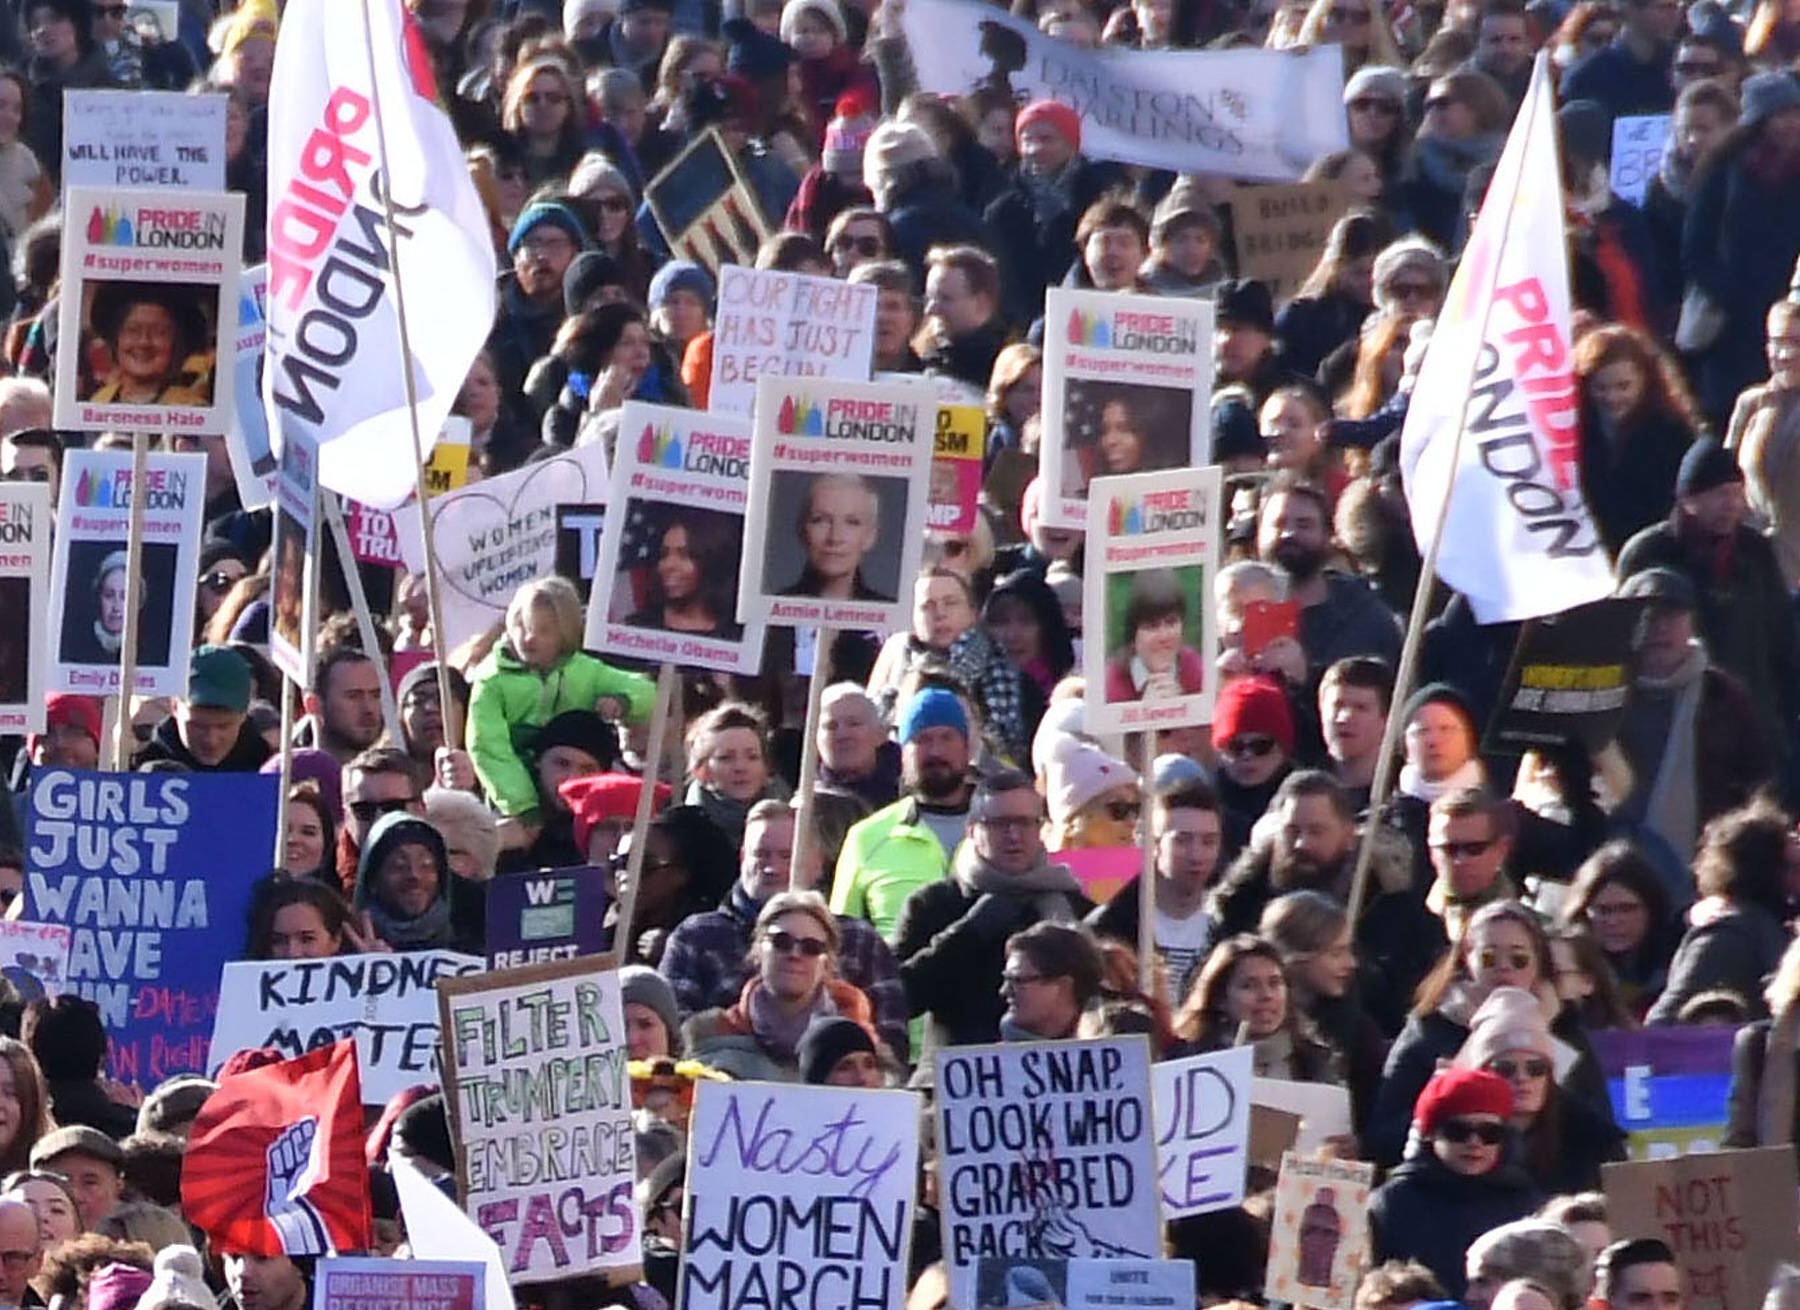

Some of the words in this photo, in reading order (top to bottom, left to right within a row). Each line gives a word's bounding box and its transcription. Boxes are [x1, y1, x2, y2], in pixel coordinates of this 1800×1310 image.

[69, 144, 109, 161] WILL
[114, 145, 160, 162] HAVE
[176, 147, 208, 163] THE
[137, 210, 201, 229] PRIDE
[203, 211, 226, 228] IN
[135, 229, 225, 249] LONDON
[83, 254, 223, 275] #superwomen
[726, 274, 788, 310] OUR
[792, 281, 874, 321] FIGHT
[722, 315, 777, 346] HAS
[784, 320, 861, 357] JUST
[1114, 312, 1174, 335] PRIDE
[1113, 332, 1196, 354] LONDON
[82, 408, 162, 425] Baroness
[167, 410, 205, 426] Hale
[829, 398, 892, 424] PRIDE
[894, 404, 917, 424] IN
[688, 432, 750, 457] PRIDE
[825, 421, 915, 443] LONDON
[773, 444, 912, 467] #superwomen
[11, 504, 32, 523] IN
[1143, 491, 1192, 510] PRIDE
[359, 513, 389, 535] TO
[469, 506, 552, 552] WOMEN
[1141, 511, 1206, 534] LONDON
[771, 603, 819, 620] Annie
[824, 605, 886, 622] Lennox
[607, 630, 677, 655] Michelle
[682, 643, 740, 664] Obama
[69, 670, 105, 689] Emily
[34, 770, 190, 825] GIRLS
[30, 826, 178, 876] JUST
[29, 872, 208, 929] WANNA
[494, 945, 579, 971] REJECT
[453, 981, 610, 1069] FILTER
[457, 1044, 630, 1129] TRUMPERY
[944, 1055, 1003, 1100] OH
[943, 1102, 1055, 1156] LOOK
[1063, 1096, 1142, 1147] WHO
[465, 1119, 636, 1192] EMBRACE
[701, 1094, 898, 1199] Nasty
[951, 1153, 1134, 1218] GRABBED
[1656, 1177, 1733, 1219] NOT
[477, 1181, 635, 1274] FACTS
[687, 1194, 906, 1263] WOMEN
[1664, 1223, 1746, 1253] THIS
[952, 1220, 1048, 1267] BACK
[413, 1276, 460, 1297] MASS
